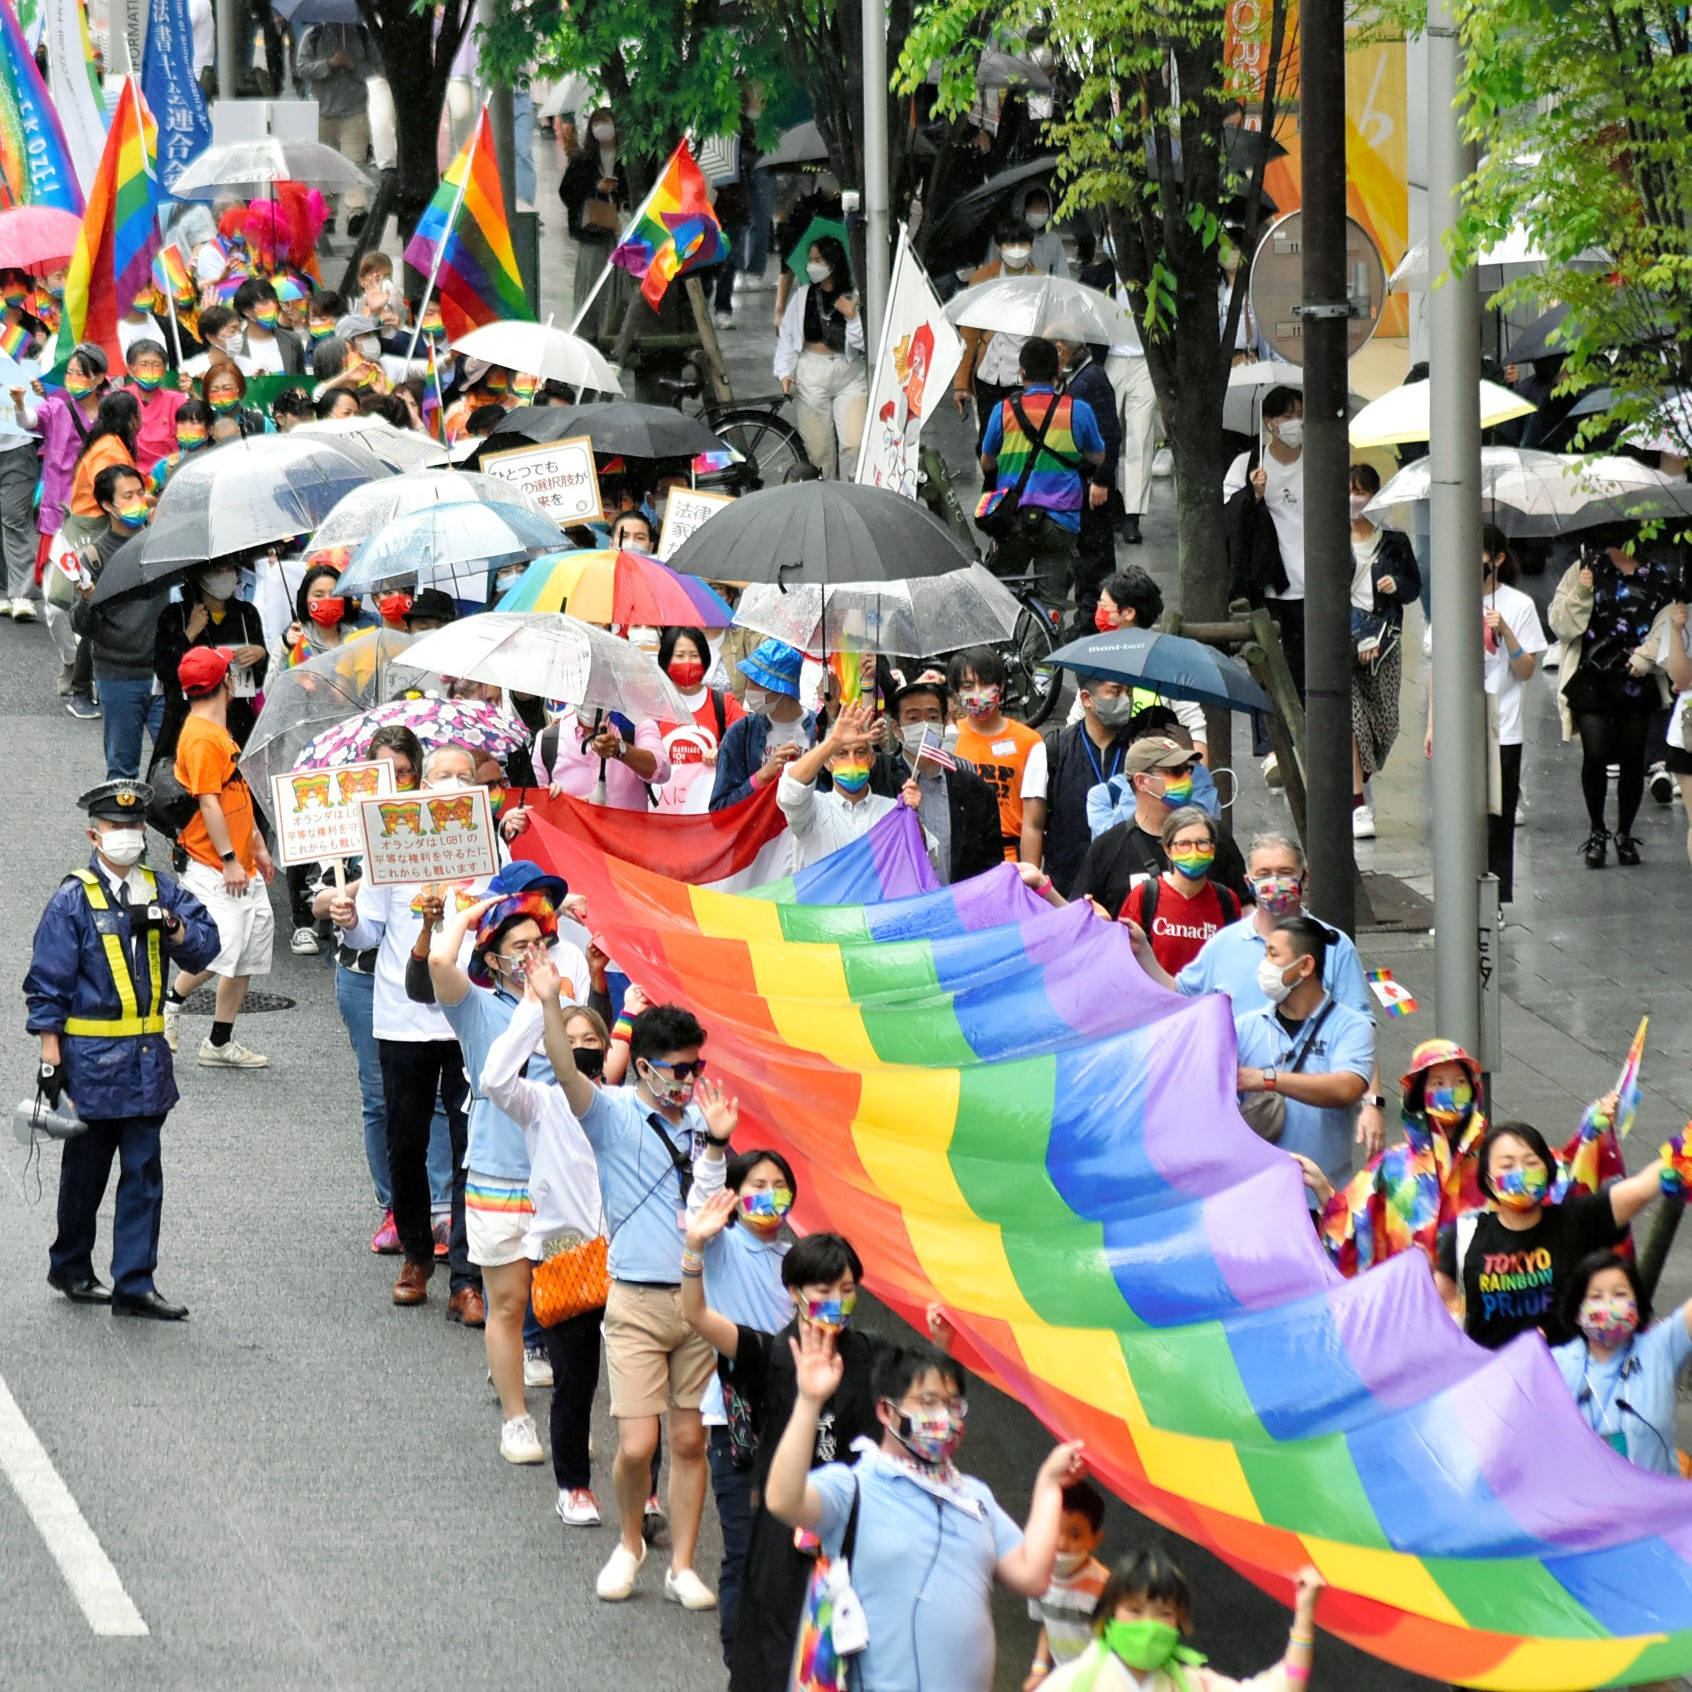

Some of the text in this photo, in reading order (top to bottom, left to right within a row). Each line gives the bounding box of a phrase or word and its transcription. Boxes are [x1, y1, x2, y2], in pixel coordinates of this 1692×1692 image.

[974, 763, 1016, 782] RP
[1484, 1248, 1552, 1274] TOKYO
[1479, 1269, 1553, 1292] RAINBOW
